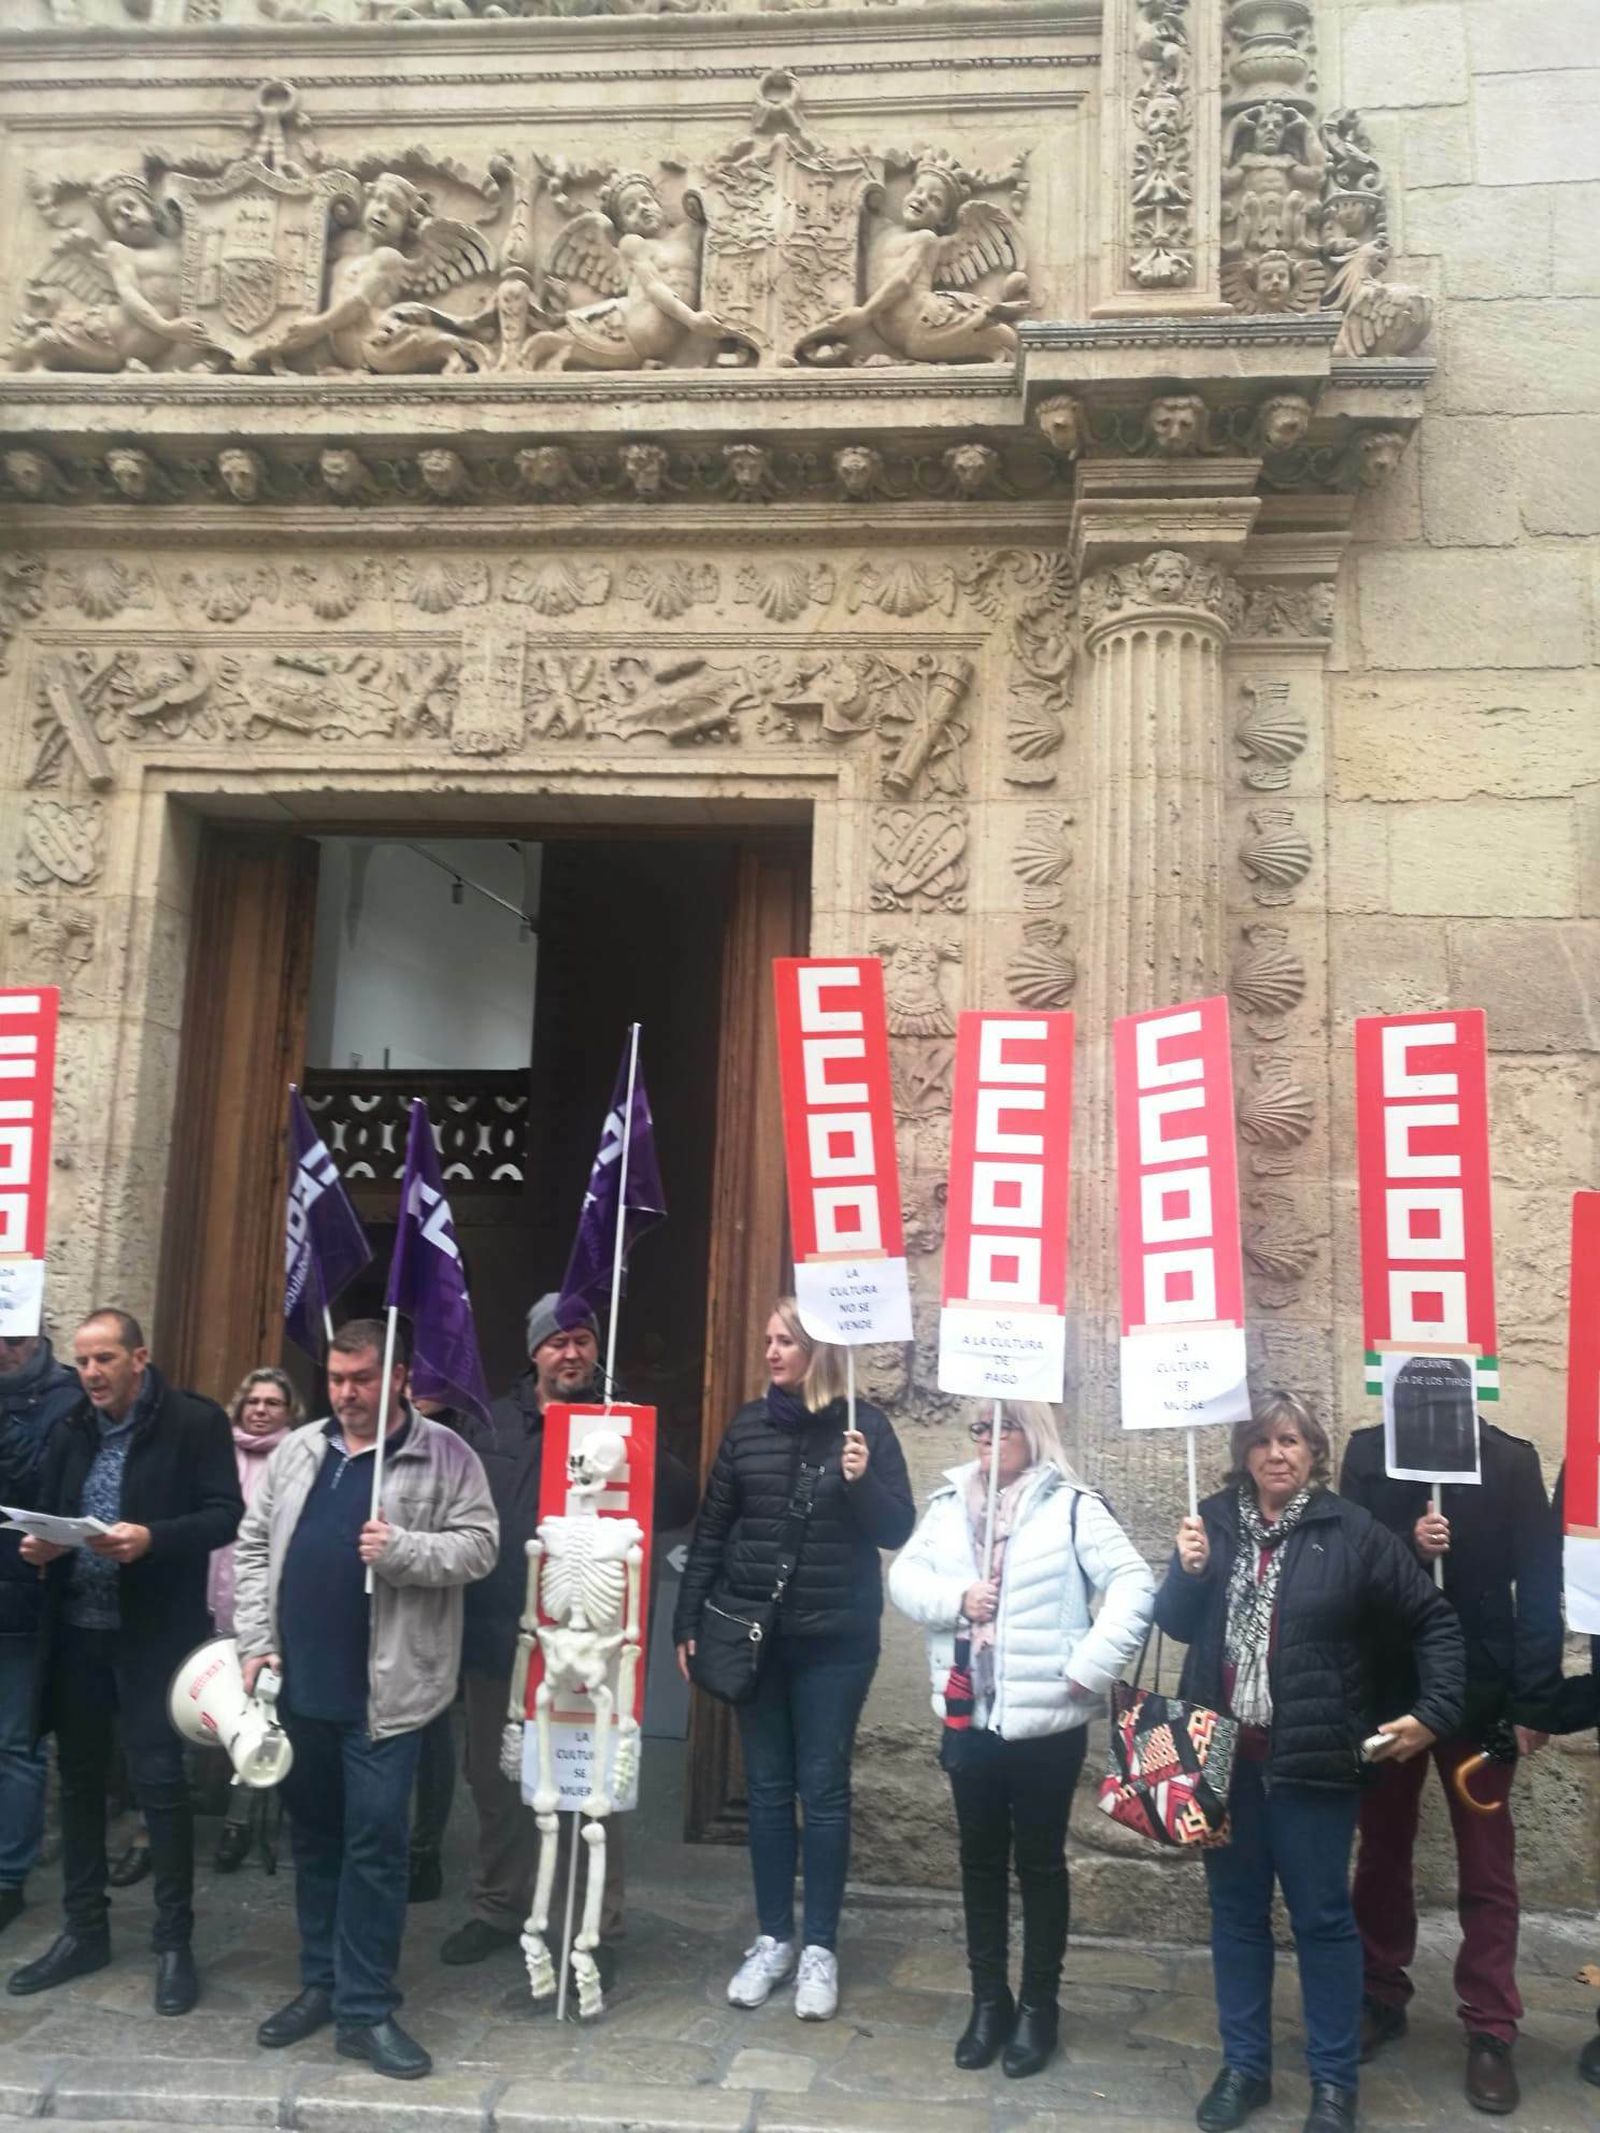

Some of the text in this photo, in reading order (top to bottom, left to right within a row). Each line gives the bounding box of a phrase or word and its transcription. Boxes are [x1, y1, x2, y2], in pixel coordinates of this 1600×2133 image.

[797, 966, 882, 1253] CCOO
[968, 1020, 1048, 1303] CCOO
[1136, 1011, 1217, 1325] CCOO
[1382, 1023, 1469, 1344] CCOO
[846, 1268, 859, 1278] LA
[829, 1285, 878, 1297] CULTURA
[840, 1302, 870, 1313] NO SE
[838, 1319, 873, 1331] VENDE
[995, 1320, 1012, 1330] NO
[974, 1337, 987, 1346] LA
[990, 1338, 1044, 1350] CULTURA
[994, 1355, 1010, 1366] DE
[1156, 1361, 1209, 1373] CULTURA
[985, 1372, 1018, 1385] PAGO
[1411, 1376, 1424, 1386] DE
[1426, 1376, 1443, 1386] LOS
[1444, 1377, 1472, 1387] TIROS
[575, 1732, 590, 1743] LA
[574, 1769, 586, 1779] SE
